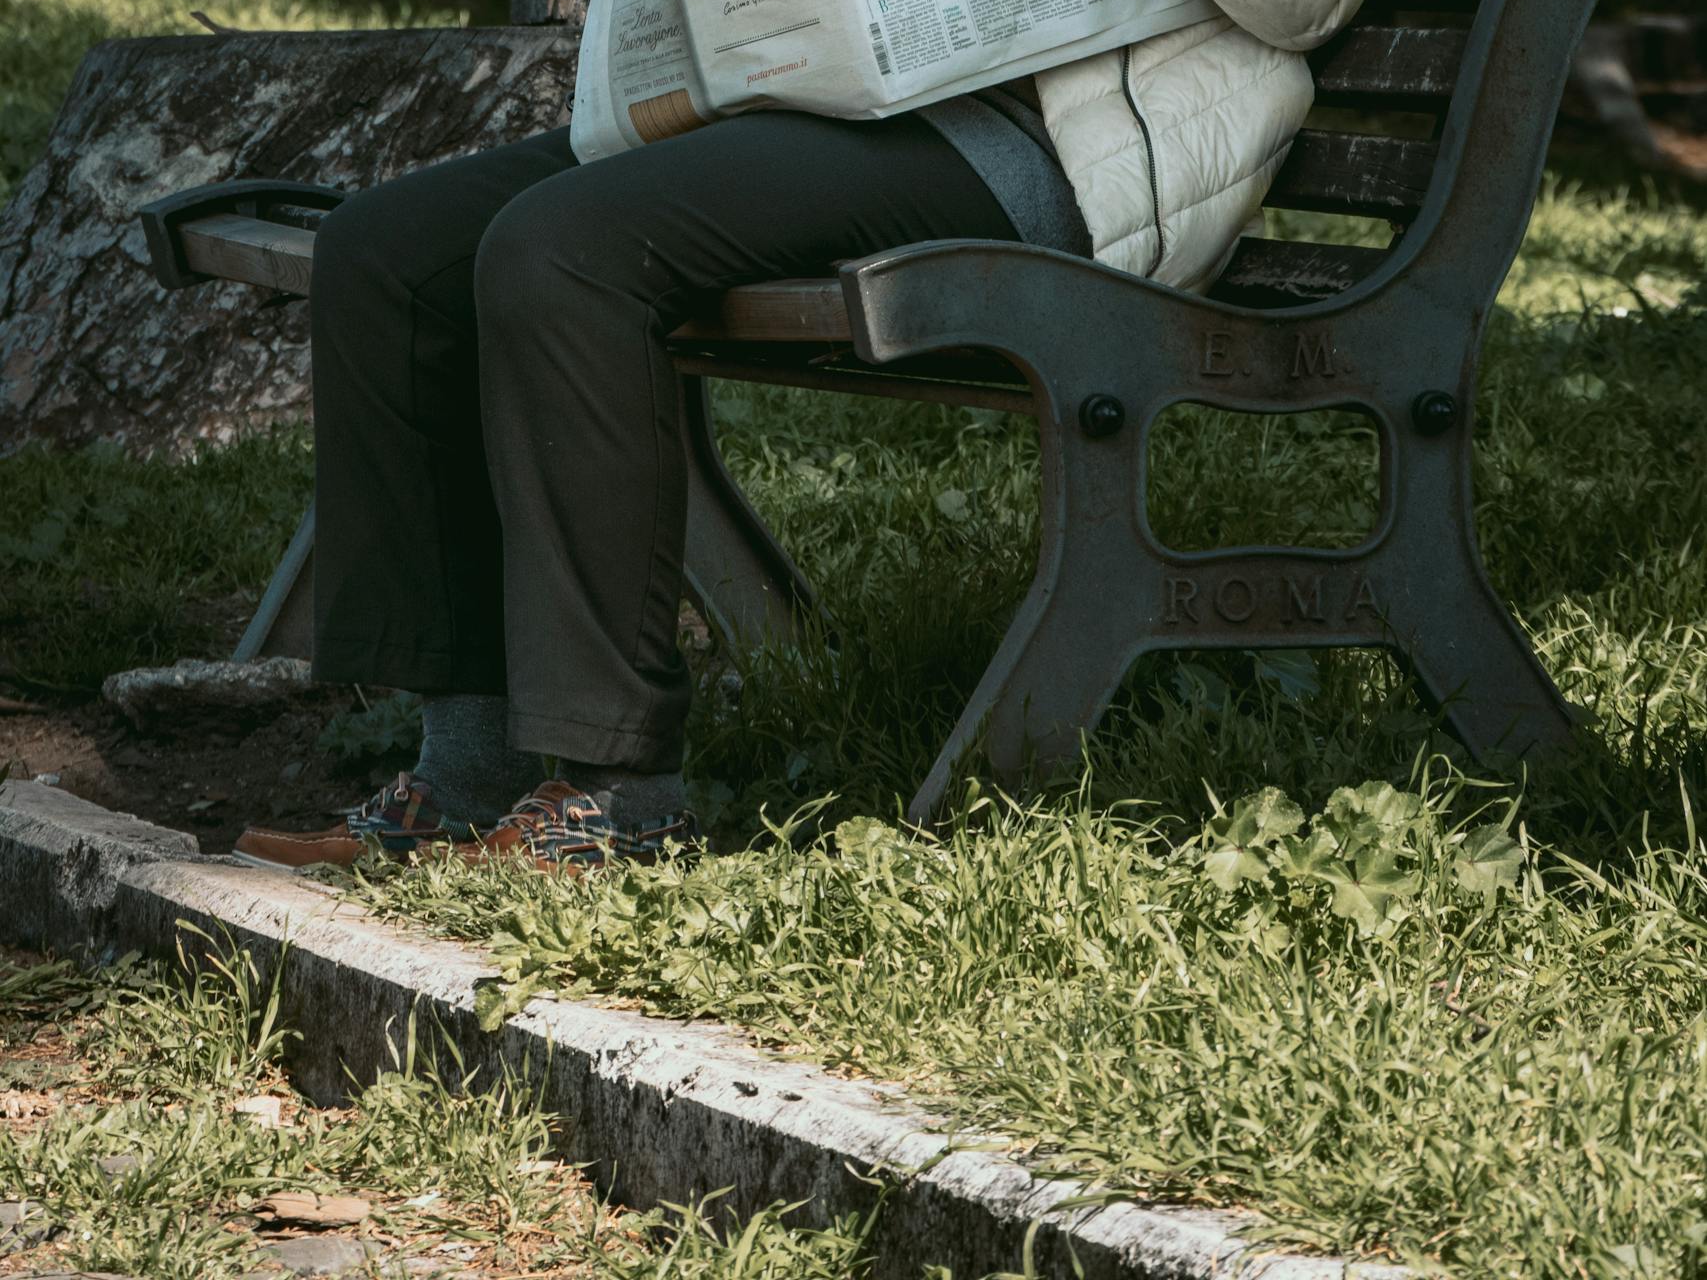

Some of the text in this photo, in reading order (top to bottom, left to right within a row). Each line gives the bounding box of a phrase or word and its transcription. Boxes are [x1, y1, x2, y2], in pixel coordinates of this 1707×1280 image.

[746, 56, 808, 87] pastarummo.it
[1200, 330, 1352, 377] E. M.
[1161, 575, 1386, 626] ROMA
